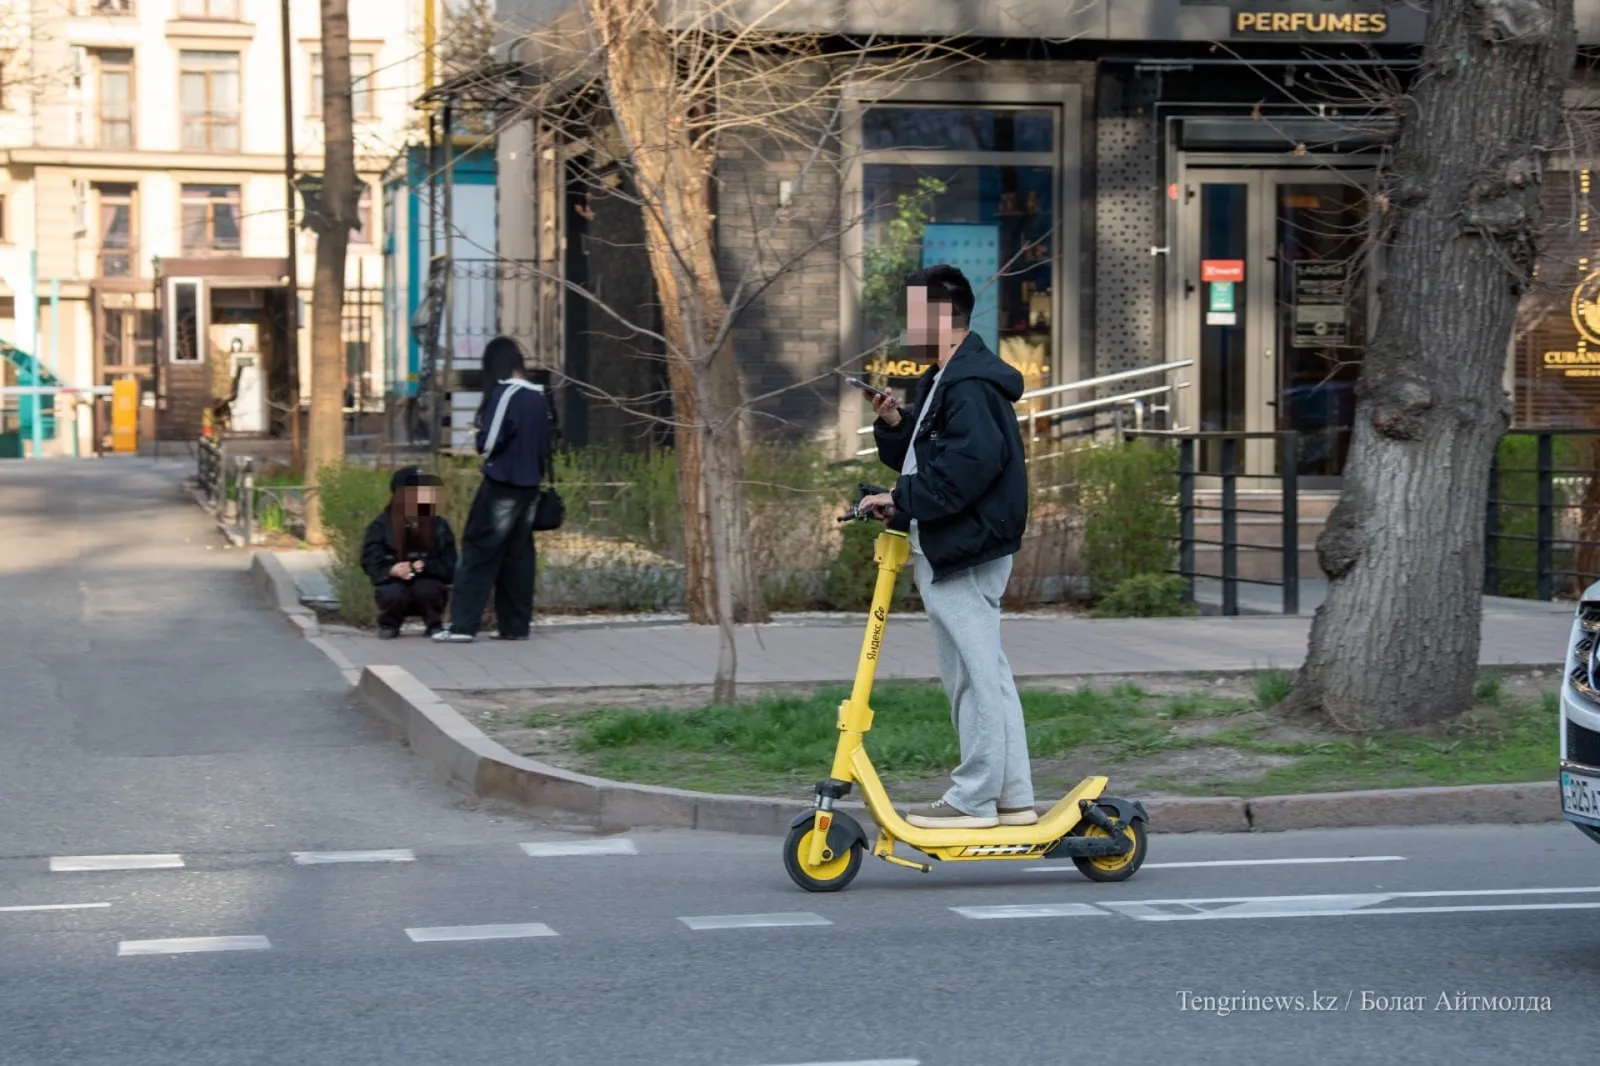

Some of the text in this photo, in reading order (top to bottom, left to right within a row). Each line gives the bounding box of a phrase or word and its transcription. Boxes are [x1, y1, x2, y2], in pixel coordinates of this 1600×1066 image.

[1236, 12, 1387, 32] PERFUMES
[866, 606, 885, 660] Яндекс Go
